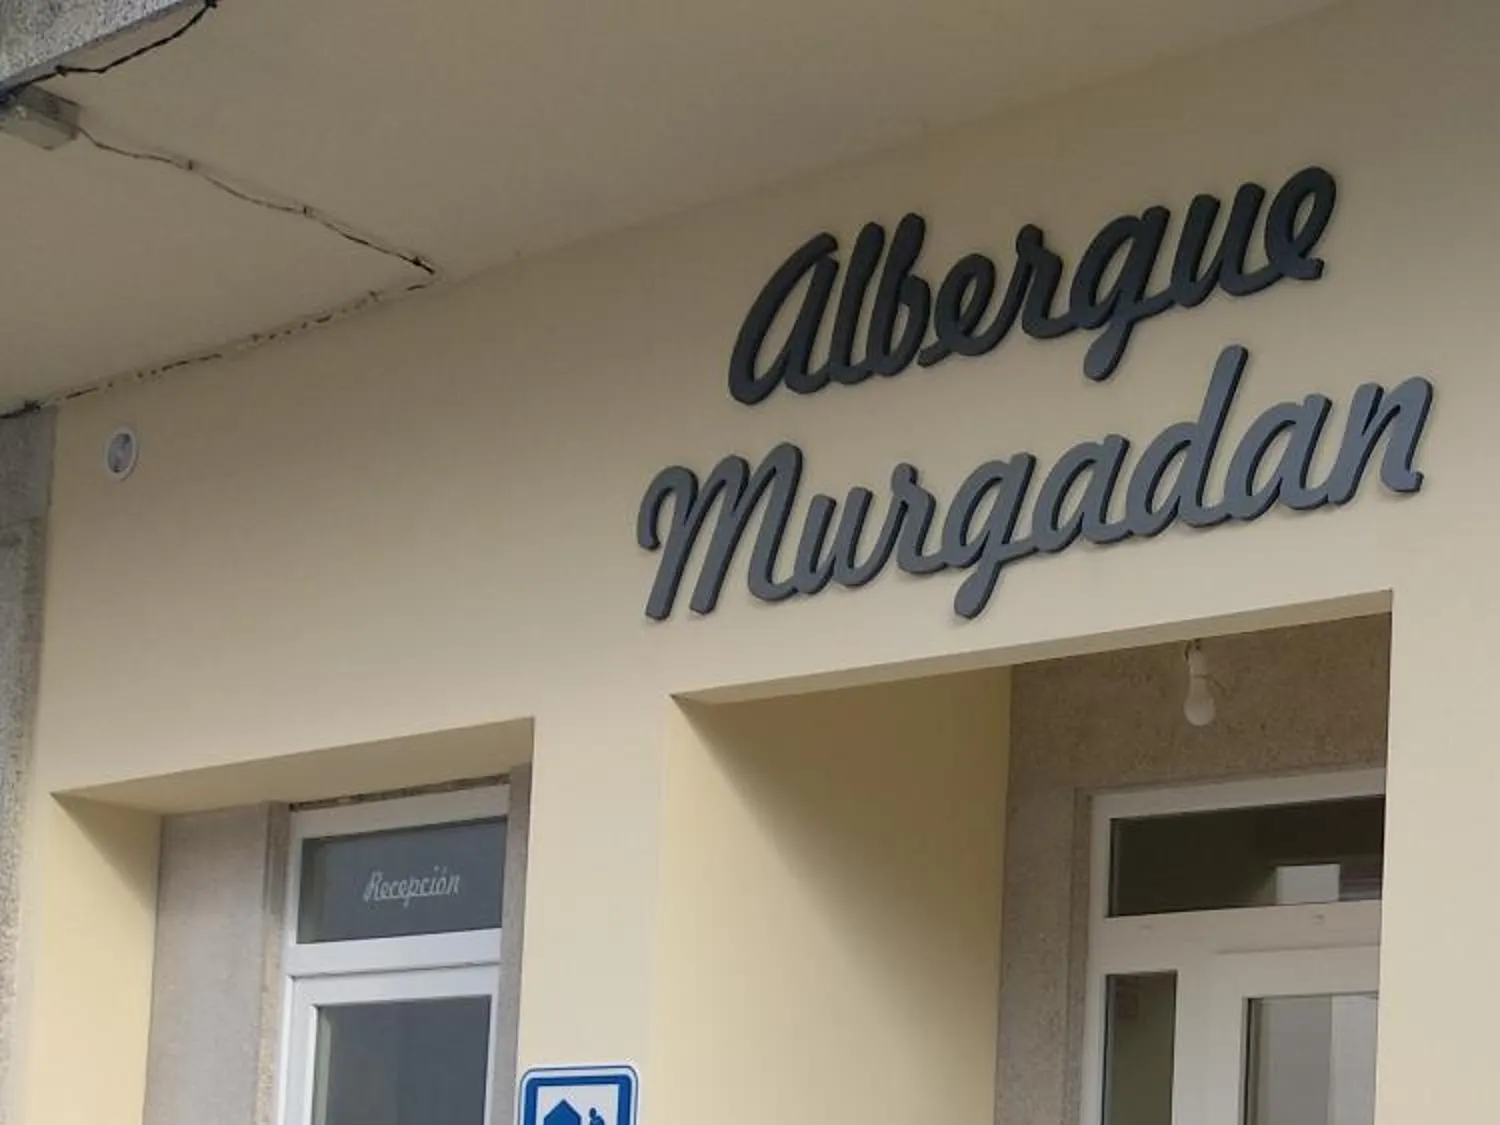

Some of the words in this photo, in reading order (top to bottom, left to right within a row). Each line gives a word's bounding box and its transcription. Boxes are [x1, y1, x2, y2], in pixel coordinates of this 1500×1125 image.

[728, 166, 1337, 405] Albergue
[637, 344, 1434, 621] Murgadan
[363, 865, 461, 908] Recepción
